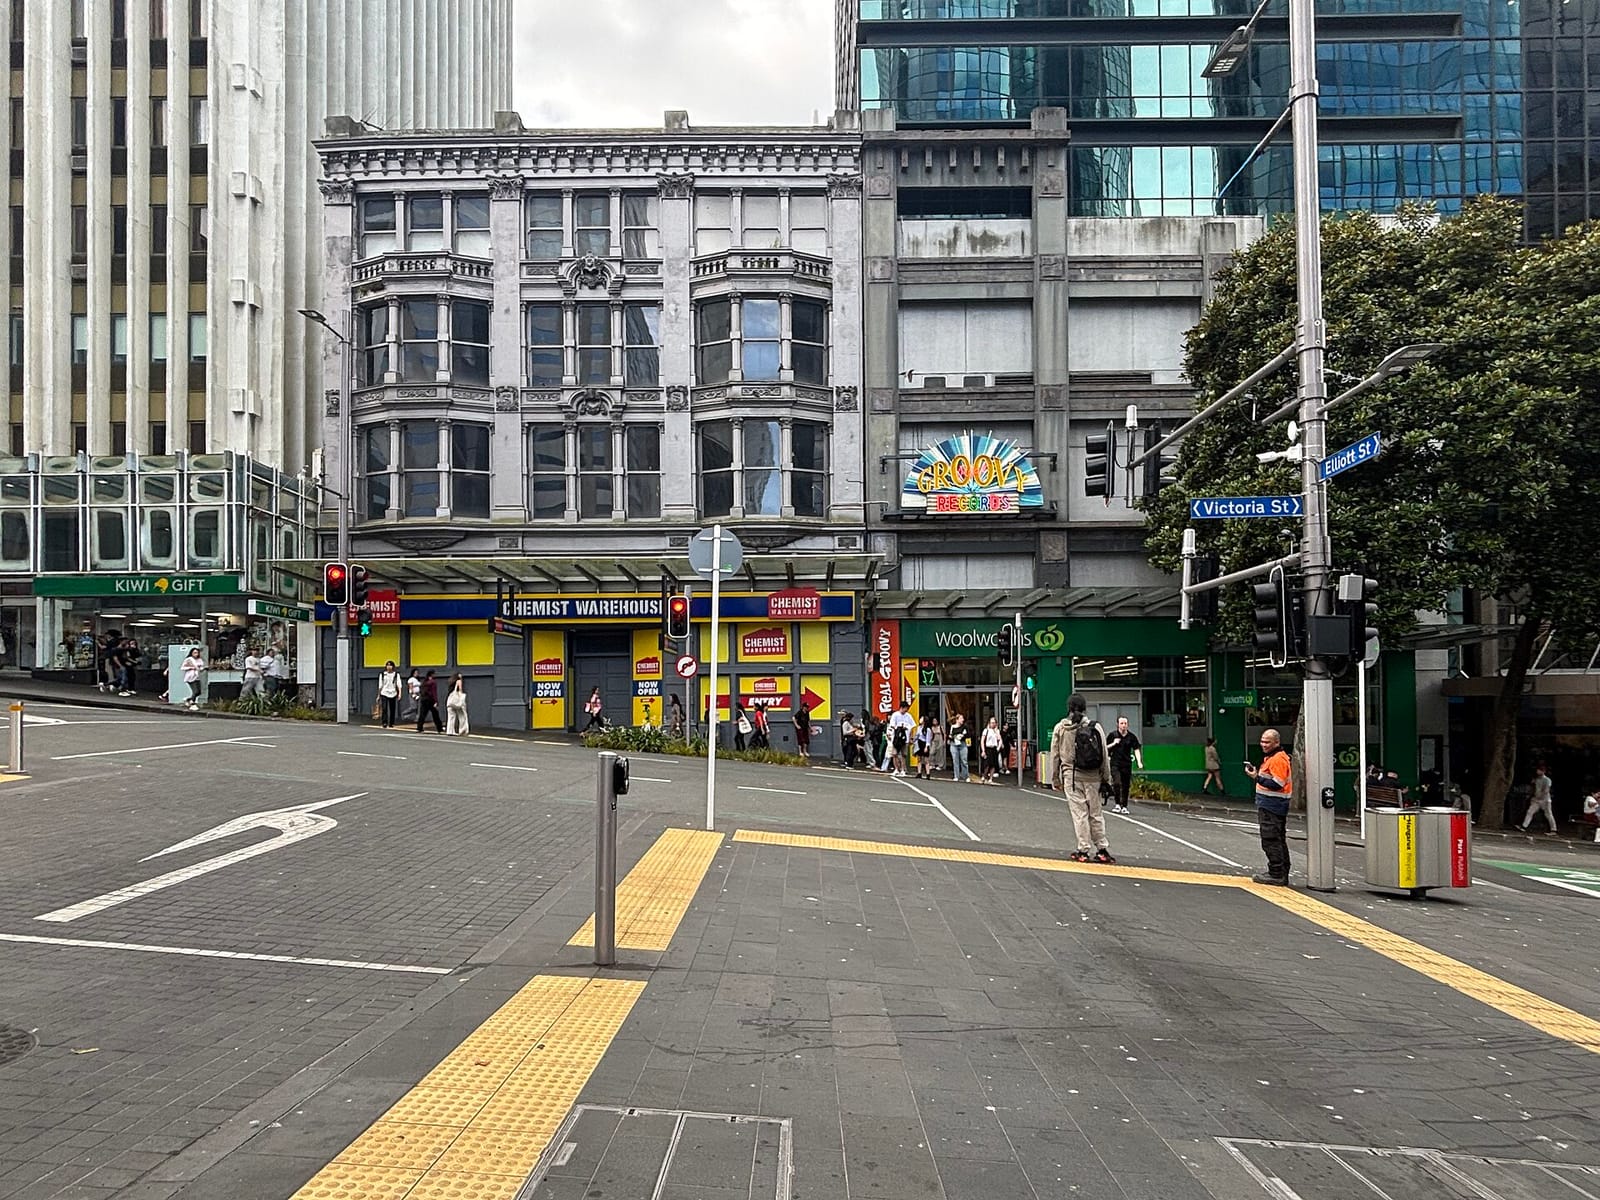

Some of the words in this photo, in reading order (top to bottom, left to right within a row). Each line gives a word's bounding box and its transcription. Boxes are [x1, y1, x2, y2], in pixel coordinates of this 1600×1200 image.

[1325, 450, 1356, 475] Elliott
[1358, 442, 1372, 459] St
[917, 454, 1028, 493] GROOVY
[936, 494, 1012, 512] RECORDS
[1203, 500, 1265, 515] Victoria
[1271, 499, 1289, 514] St
[115, 579, 149, 592] KIWI
[171, 579, 206, 592] GIFT
[502, 600, 570, 616] CHEMIST
[771, 597, 818, 609] CHEMIST
[265, 604, 281, 614] KIWI
[288, 608, 302, 619] GIFT
[744, 637, 785, 648] CHEMIST
[537, 682, 561, 690] NOW
[638, 681, 658, 689] NOW
[536, 689, 562, 697] OPEN
[637, 687, 659, 696] OPEN
[748, 696, 784, 707] ENTRY
